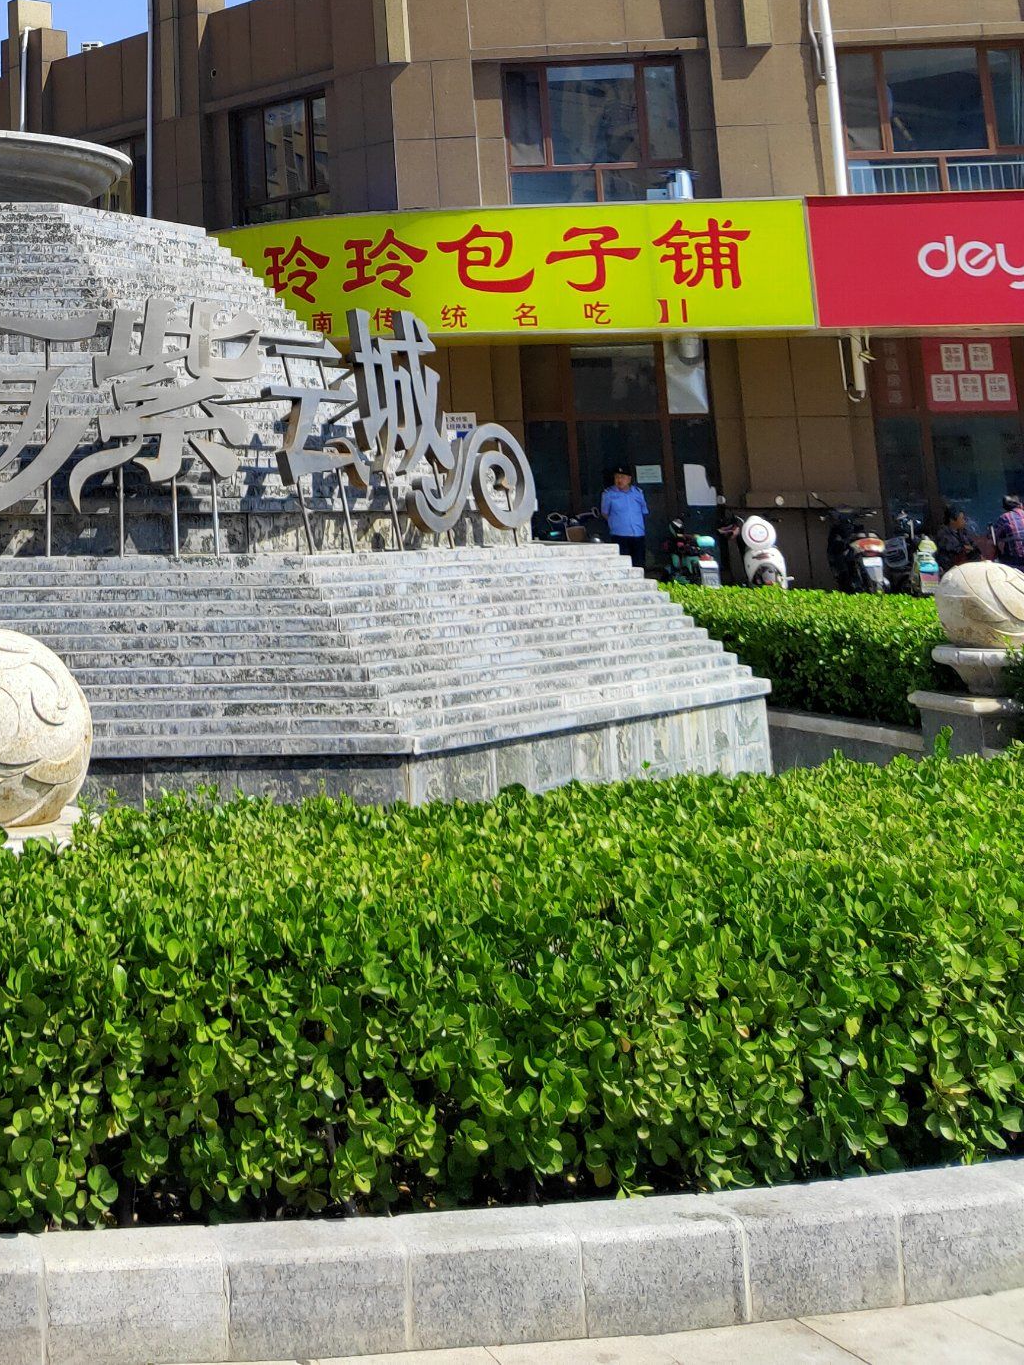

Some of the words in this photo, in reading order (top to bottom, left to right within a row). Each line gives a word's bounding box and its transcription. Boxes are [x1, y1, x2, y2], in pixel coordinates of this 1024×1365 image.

[242, 217, 751, 304] 玲玲包子铺
[917, 235, 1024, 290] dey
